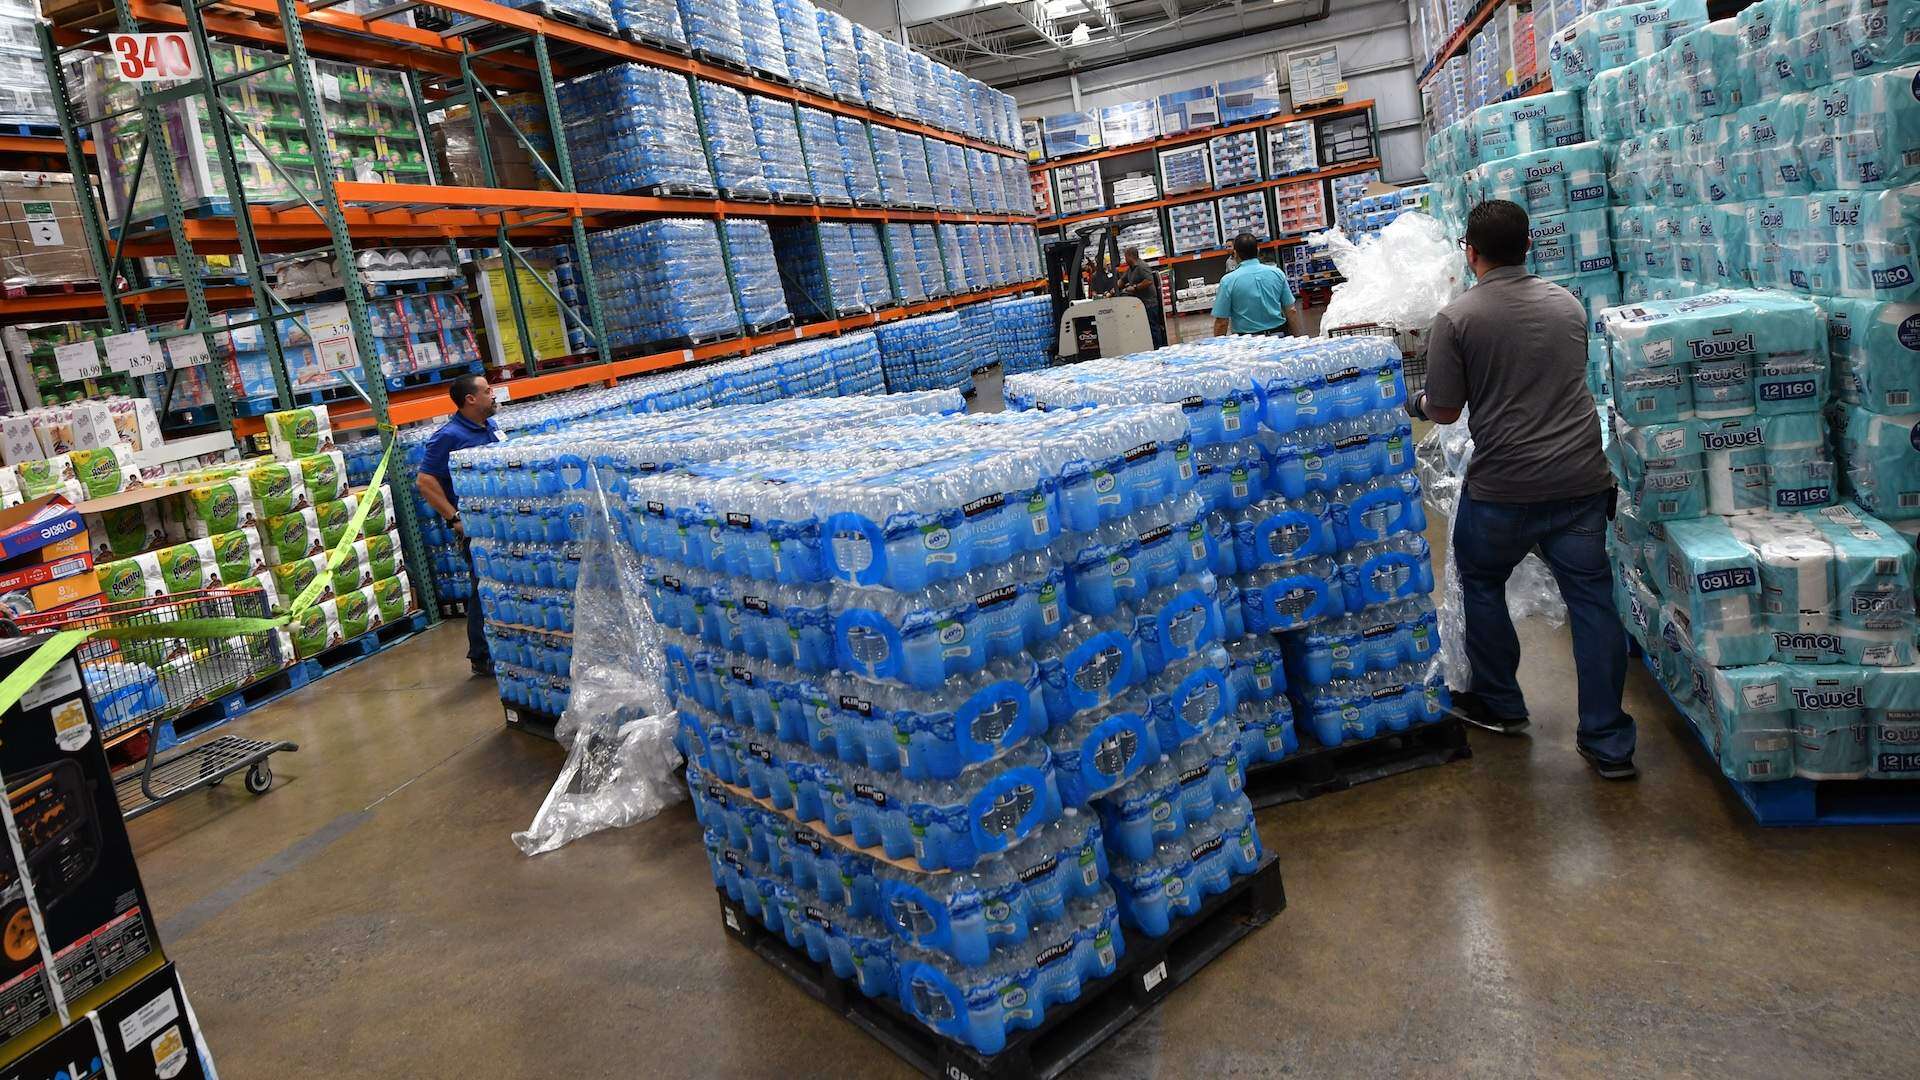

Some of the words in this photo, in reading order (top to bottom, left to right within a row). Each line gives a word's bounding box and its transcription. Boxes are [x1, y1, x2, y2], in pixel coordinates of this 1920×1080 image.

[1633, 8, 1670, 25] Towel
[115, 35, 192, 78] 340
[1513, 105, 1548, 121] Towel
[1526, 161, 1564, 178] Towel
[1572, 191, 1583, 199] 12
[1586, 187, 1603, 197] 160
[1529, 222, 1566, 239] Towel
[1582, 261, 1592, 269] 12
[332, 323, 350, 336] 3.79
[1905, 319, 1920, 328] NE
[1689, 333, 1756, 357] Towel
[129, 355, 152, 369] 18.79
[189, 354, 209, 365] 10.99
[78, 366, 100, 378] 10.99
[1326, 367, 1360, 380] KIRKLAN
[1763, 384, 1778, 396] 12
[1786, 382, 1815, 395] 160
[1335, 434, 1369, 446] KIRKLAN
[1701, 426, 1765, 450] Towel
[91, 458, 116, 478] Bounty
[963, 493, 1005, 513] KIRKLAN
[1031, 494, 1042, 503] 40
[1779, 491, 1795, 502] 12
[928, 533, 948, 544] 60%
[112, 570, 141, 597] Bounty
[1701, 575, 1729, 590] 160
[1735, 573, 1751, 584] 12
[975, 584, 1018, 606] KIRKLAN
[1042, 585, 1053, 595] 40
[1772, 632, 1846, 657] Towel
[1792, 687, 1865, 711] Towel
[1883, 755, 1898, 767] 12
[1908, 755, 1920, 767] 16
[1037, 939, 1075, 963] KIRKLAN
